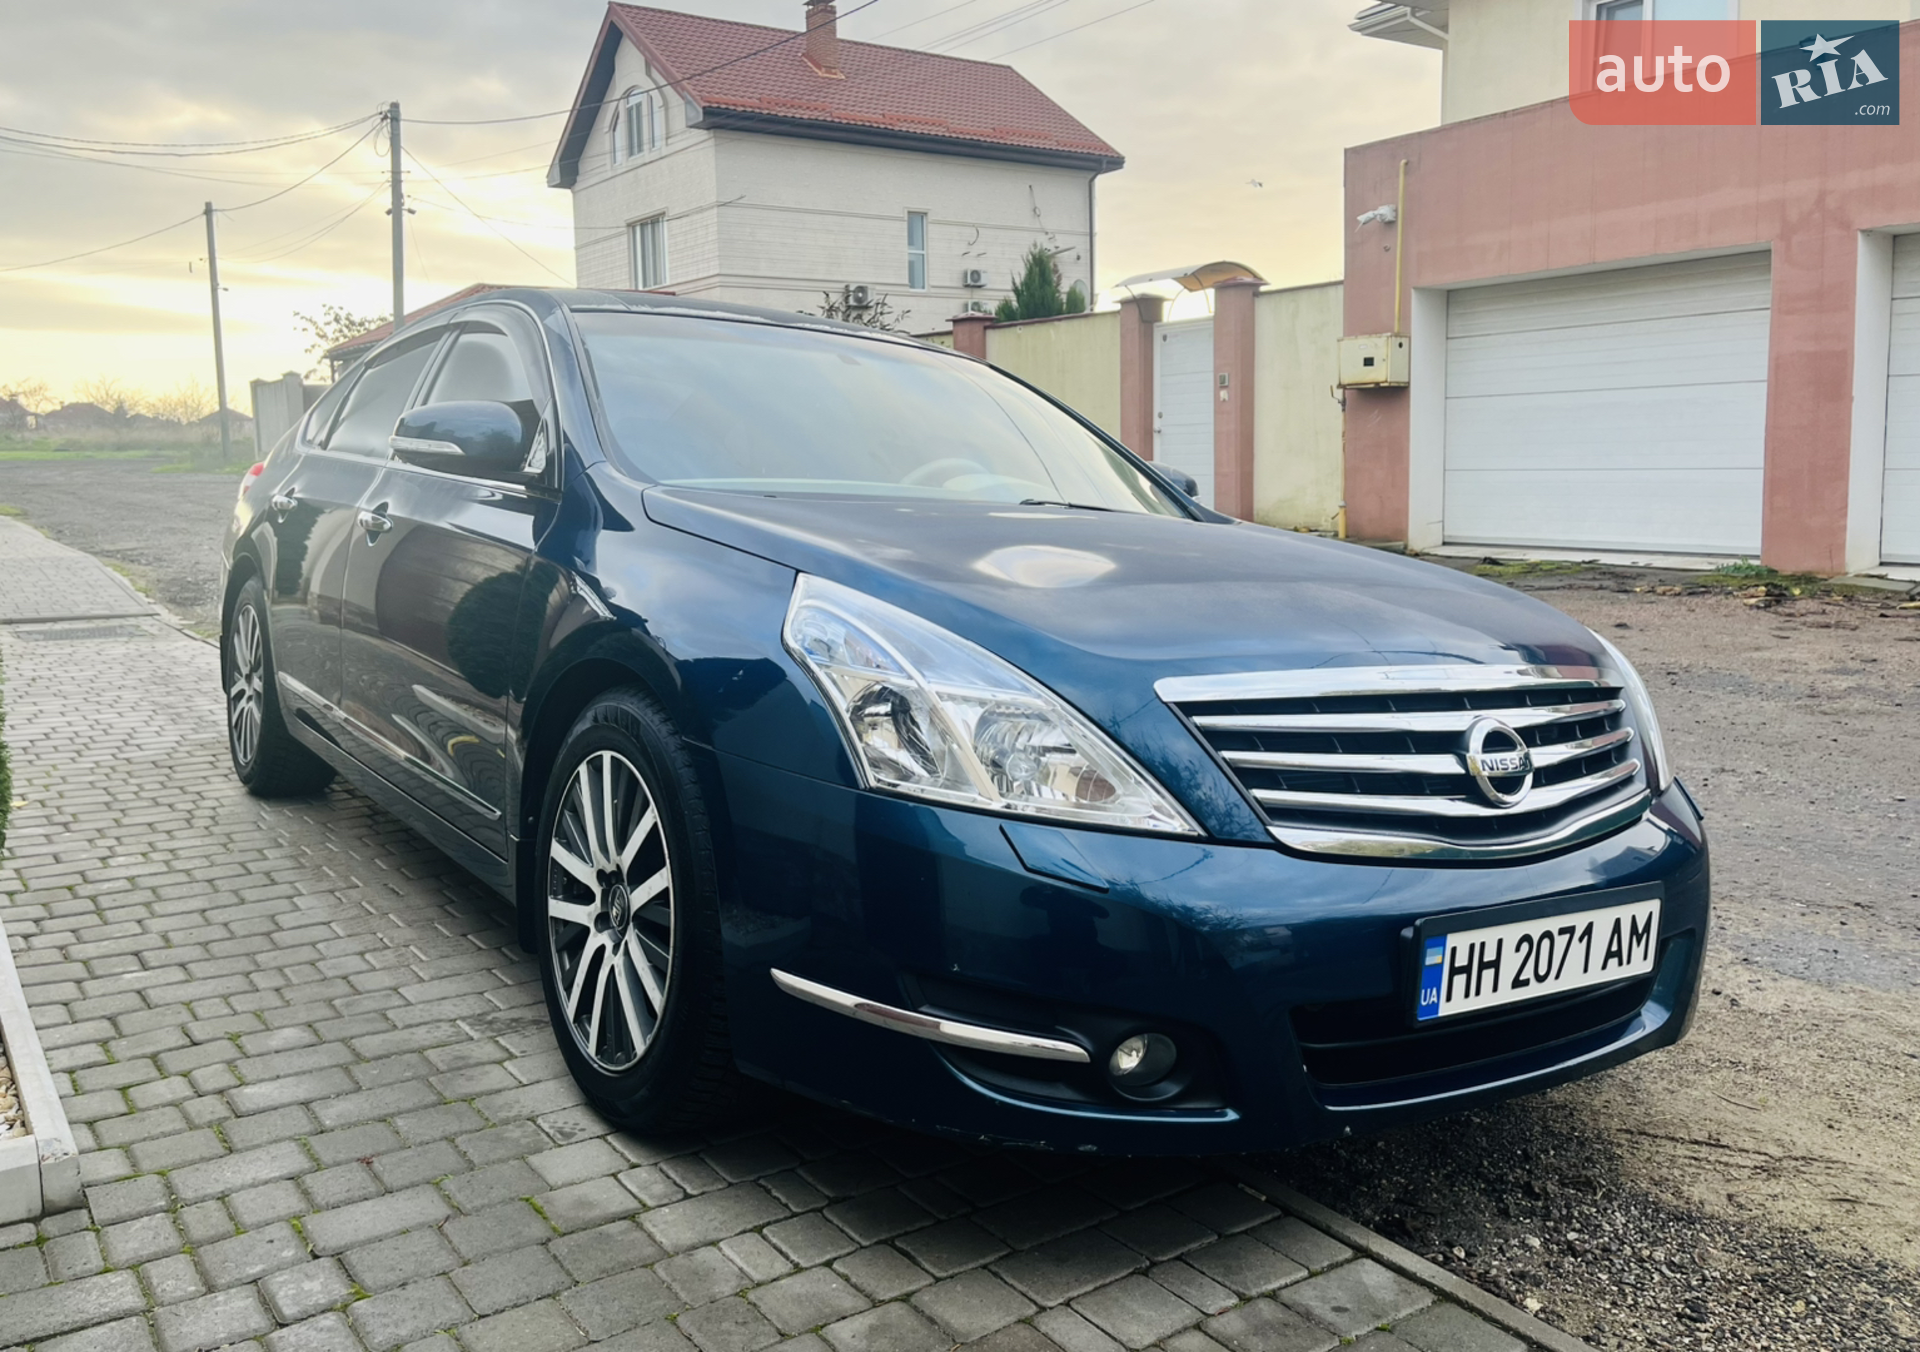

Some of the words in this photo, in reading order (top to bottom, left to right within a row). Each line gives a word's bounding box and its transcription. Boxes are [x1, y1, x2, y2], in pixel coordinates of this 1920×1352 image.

[1445, 937, 1504, 1003] HH
[1511, 920, 1594, 990] 2071
[1601, 910, 1653, 971] AM
[1421, 986, 1438, 1006] UA
